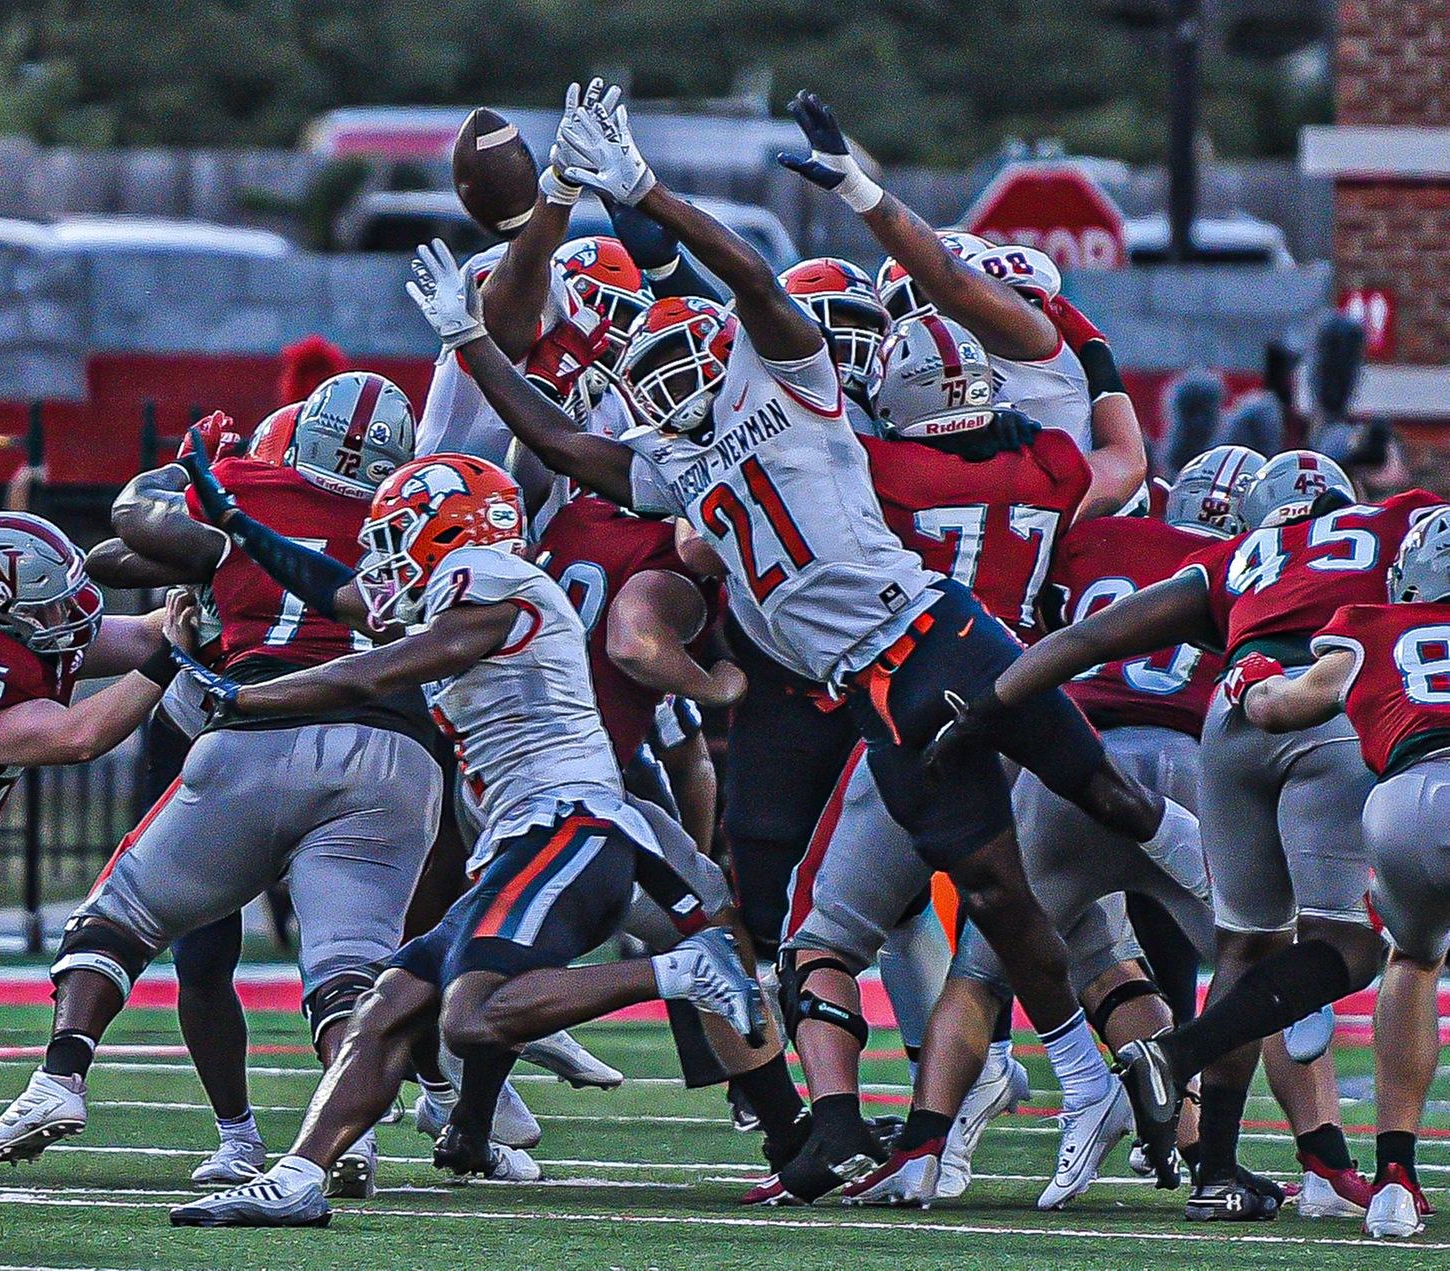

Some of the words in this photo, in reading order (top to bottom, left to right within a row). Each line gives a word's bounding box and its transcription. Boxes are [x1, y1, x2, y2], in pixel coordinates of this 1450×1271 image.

[981, 227, 1118, 271] OP
[941, 379, 968, 407] 77
[926, 415, 985, 435] Riddell
[334, 450, 362, 480] 72
[699, 452, 818, 607] 21
[1225, 504, 1383, 596] 45
[912, 503, 1062, 629] 77
